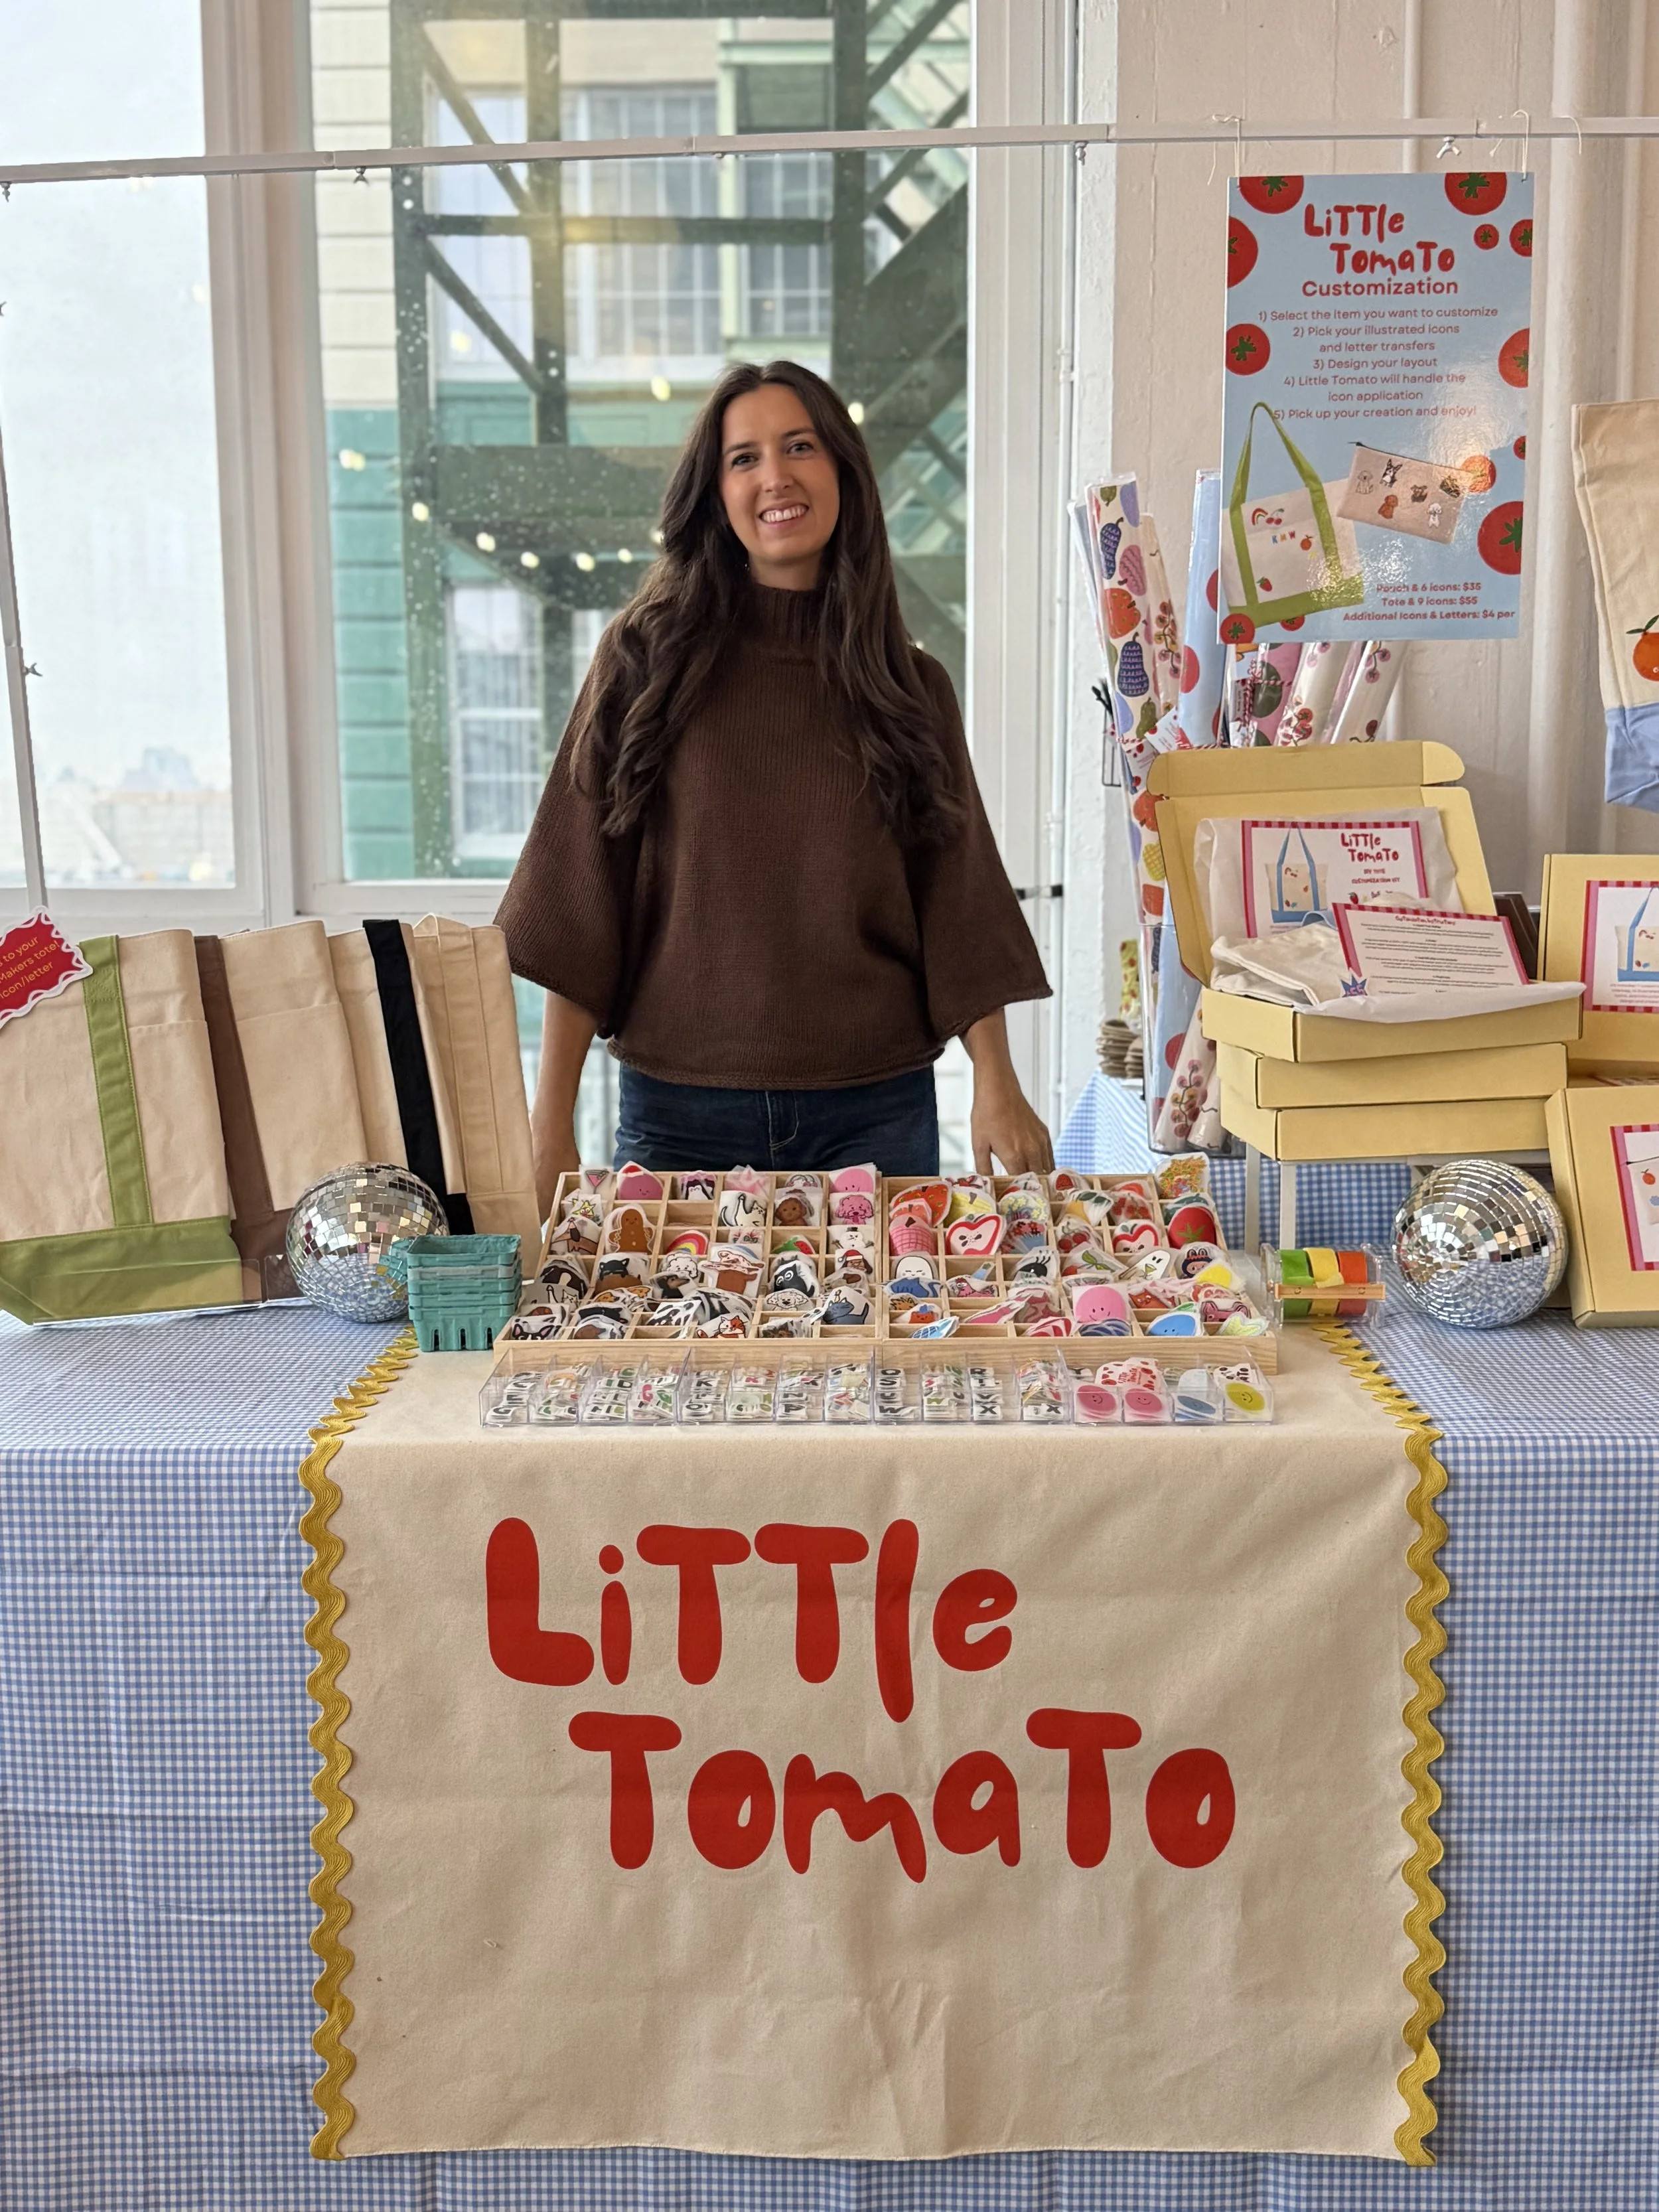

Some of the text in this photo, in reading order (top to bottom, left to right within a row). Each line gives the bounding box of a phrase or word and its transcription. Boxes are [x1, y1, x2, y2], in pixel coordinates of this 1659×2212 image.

[1302, 277, 1458, 297] Customization
[1260, 312, 1267, 321] 1)
[1271, 311, 1307, 320] Select
[1312, 311, 1331, 319] the
[1364, 309, 1385, 321] you
[1388, 309, 1417, 318] want
[1421, 309, 1433, 318] to
[1436, 307, 1498, 317] customize
[1293, 325, 1460, 338] 2) Pick your illustrated icons
[1320, 341, 1435, 352] and letter transfers
[1313, 358, 1437, 371] 3) Design your layout
[1284, 374, 1465, 388] 4) Little Tomato will handle the
[1329, 392, 1423, 403] icon application
[1273, 406, 1477, 421] 5) Pick up your creation and enjoy!
[1430, 583, 1460, 592] icons:
[1463, 582, 1480, 592] $35
[1382, 598, 1405, 607] Tote
[1417, 597, 1424, 606] 9
[1427, 597, 1457, 605] icons:
[1460, 596, 1477, 605] $55
[1344, 613, 1398, 621] Additional
[1440, 611, 1479, 619] Letters:
[1482, 610, 1494, 619] $4
[1497, 611, 1515, 620] per
[3, 936, 38, 962] to your
[34, 940, 60, 959] tote!
[980, 1406, 997, 1414] X
[1046, 1404, 1061, 1414] X
